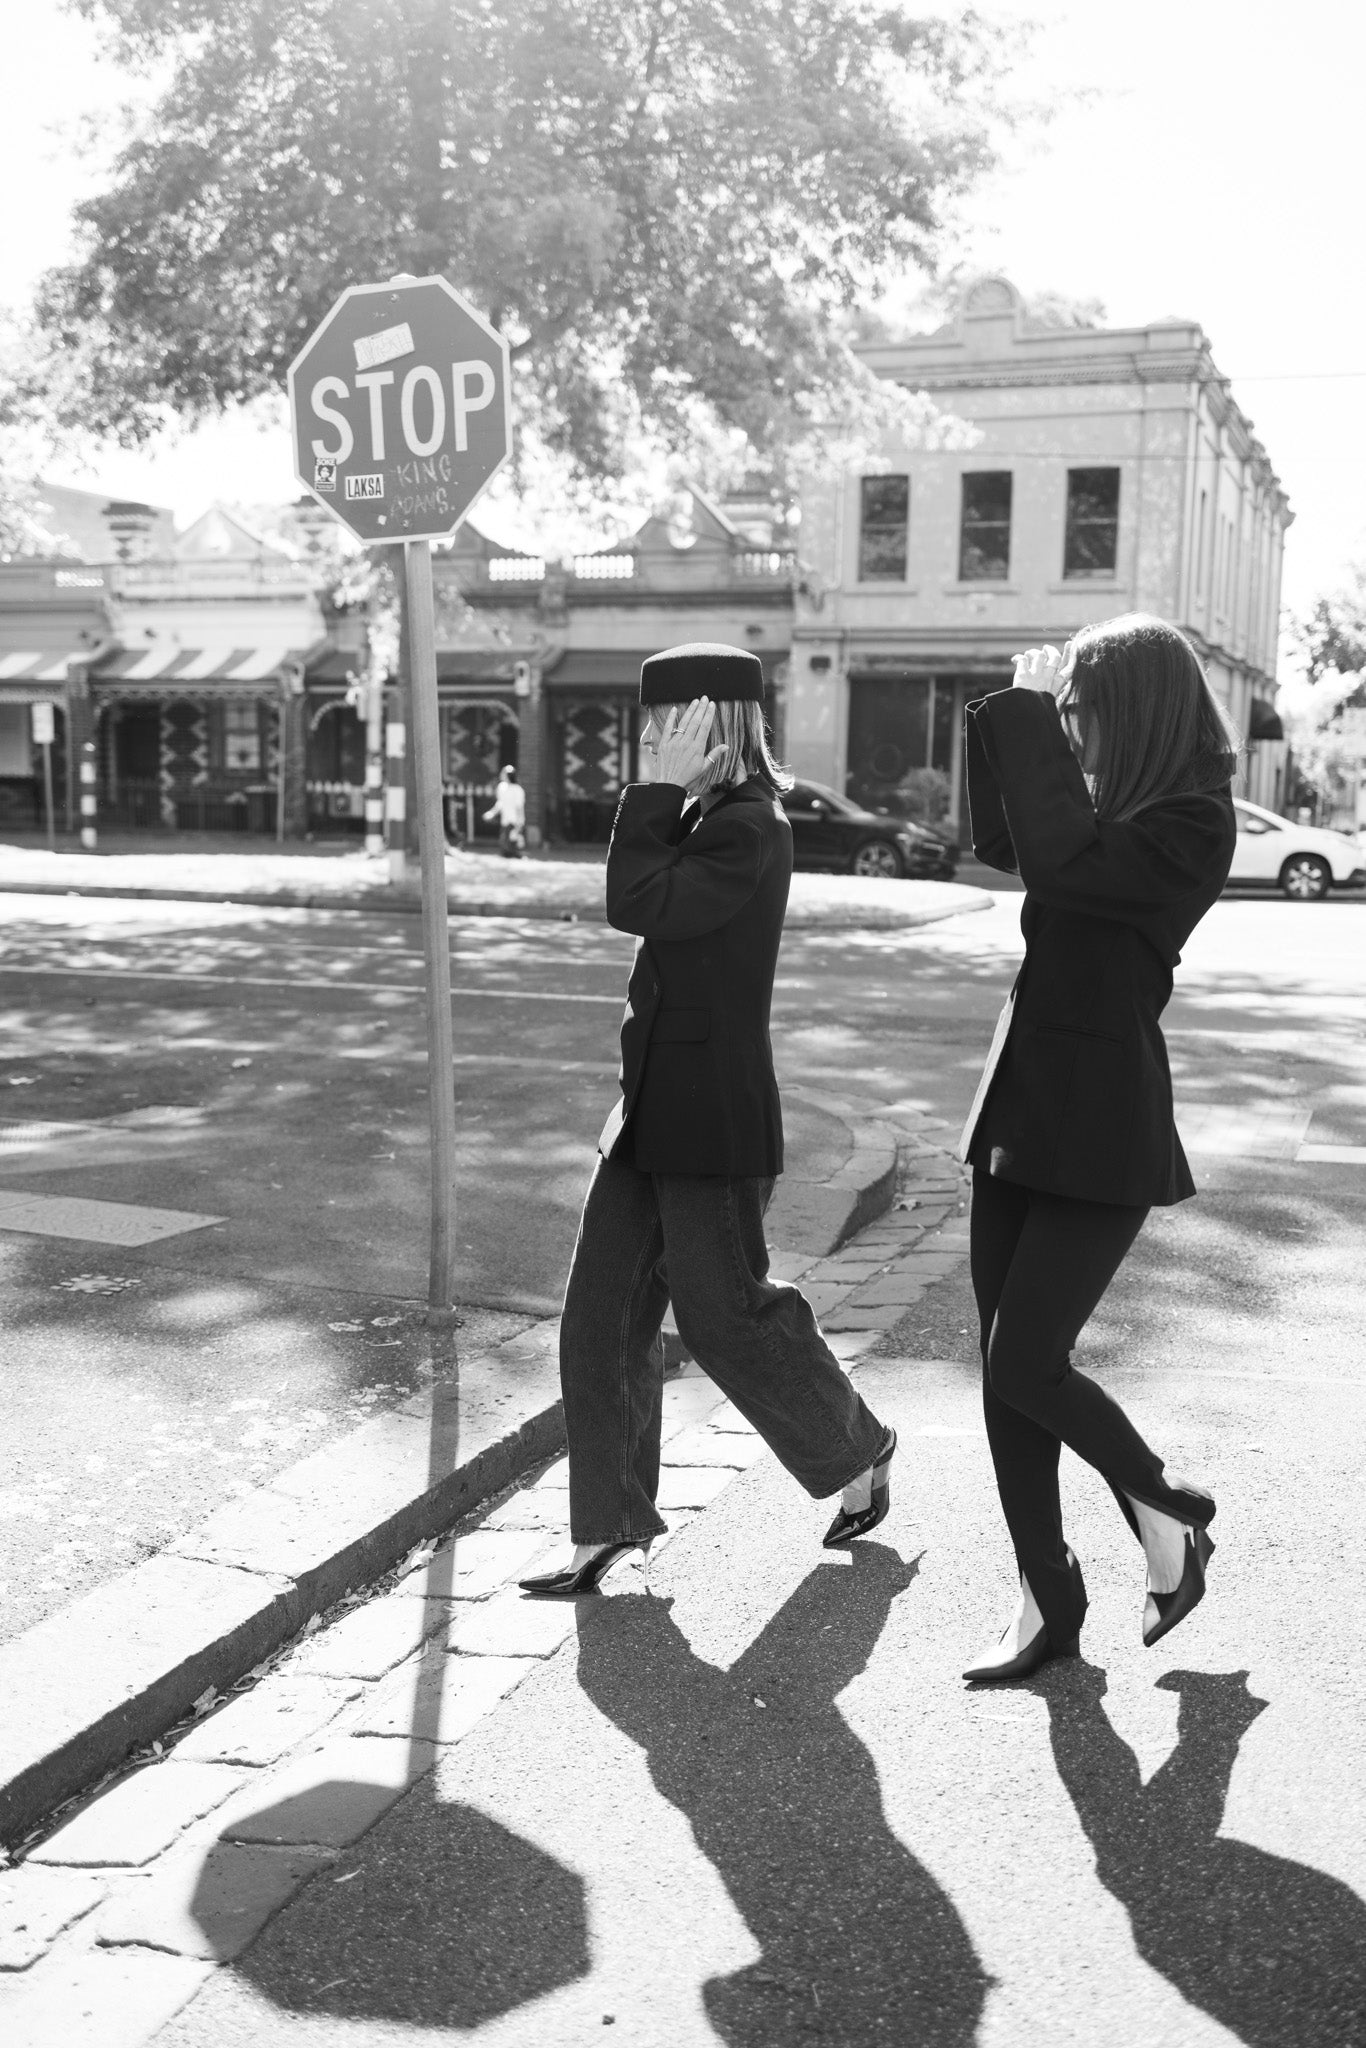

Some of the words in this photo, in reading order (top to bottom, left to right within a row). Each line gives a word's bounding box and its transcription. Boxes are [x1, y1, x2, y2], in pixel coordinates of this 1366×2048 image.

[311, 360, 495, 465] STOP
[396, 454, 452, 486] KING
[347, 477, 383, 498] LAKSA
